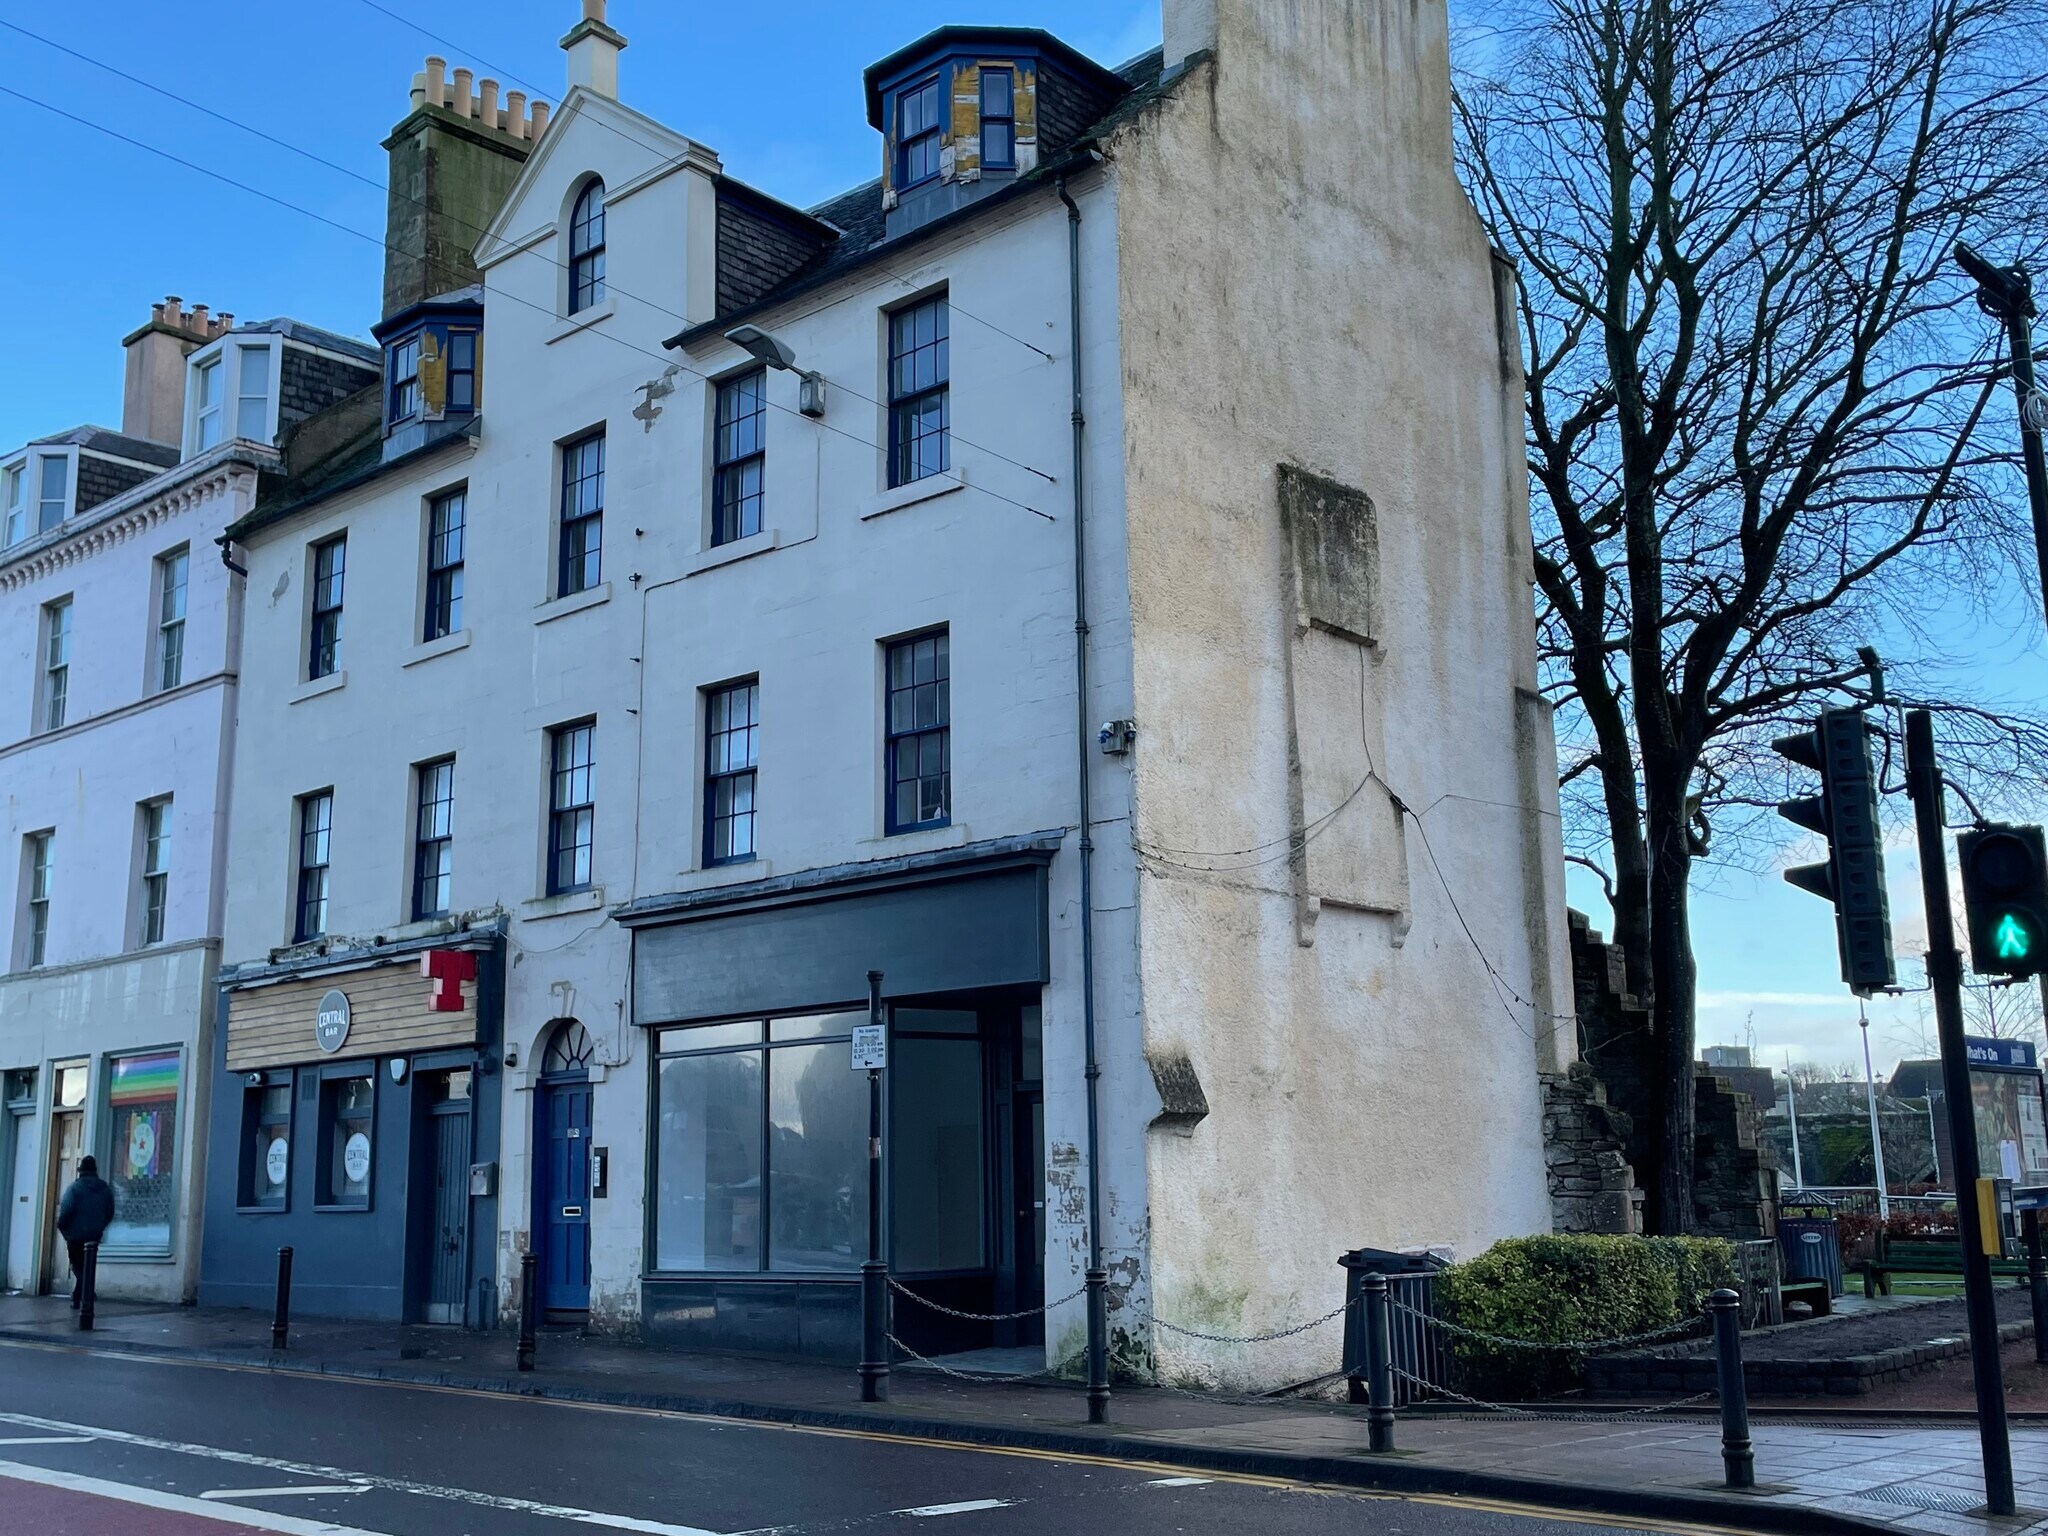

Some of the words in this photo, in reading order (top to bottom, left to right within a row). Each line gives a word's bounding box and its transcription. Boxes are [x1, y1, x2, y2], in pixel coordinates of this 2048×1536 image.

[319, 1009, 346, 1028] CENTRAL
[324, 1027, 338, 1037] BAR
[1967, 1046, 1987, 1061] hat's
[1988, 1047, 1999, 1061] On
[347, 1148, 368, 1161] CENTRAL
